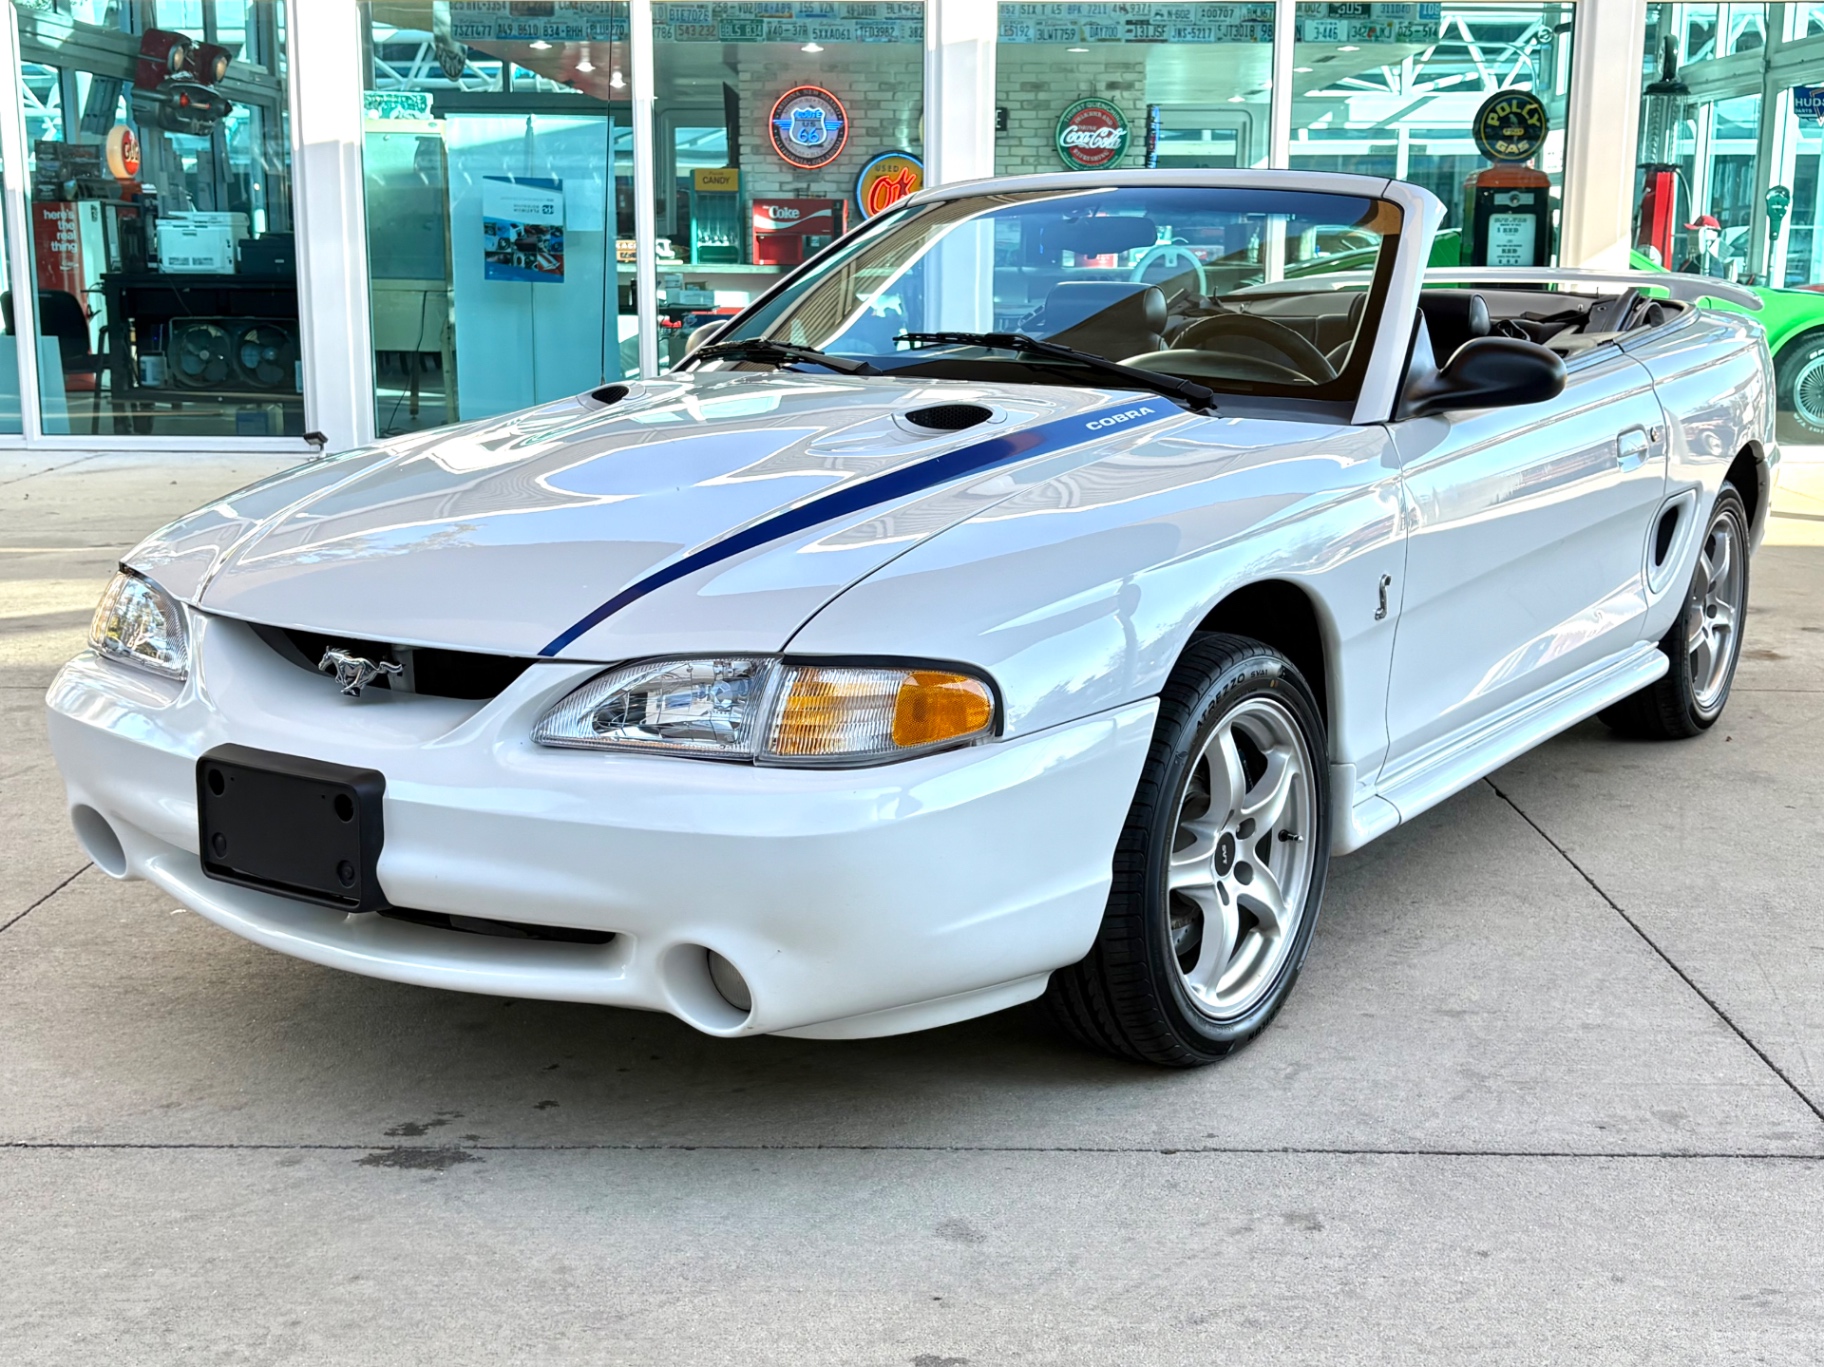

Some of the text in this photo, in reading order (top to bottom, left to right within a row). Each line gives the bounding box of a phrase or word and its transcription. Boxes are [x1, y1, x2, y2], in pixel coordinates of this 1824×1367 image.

[698, 25, 716, 37] 232
[1487, 99, 1541, 127] POLLY
[797, 127, 819, 143] 66
[1495, 140, 1530, 154] GAS
[875, 164, 900, 172] USED
[702, 176, 731, 185] CANDY
[43, 209, 75, 220] here's
[768, 205, 800, 219] Coke
[57, 220, 75, 231] the
[56, 230, 76, 241] real
[50, 240, 78, 254] thing
[1085, 406, 1156, 431] COBRA
